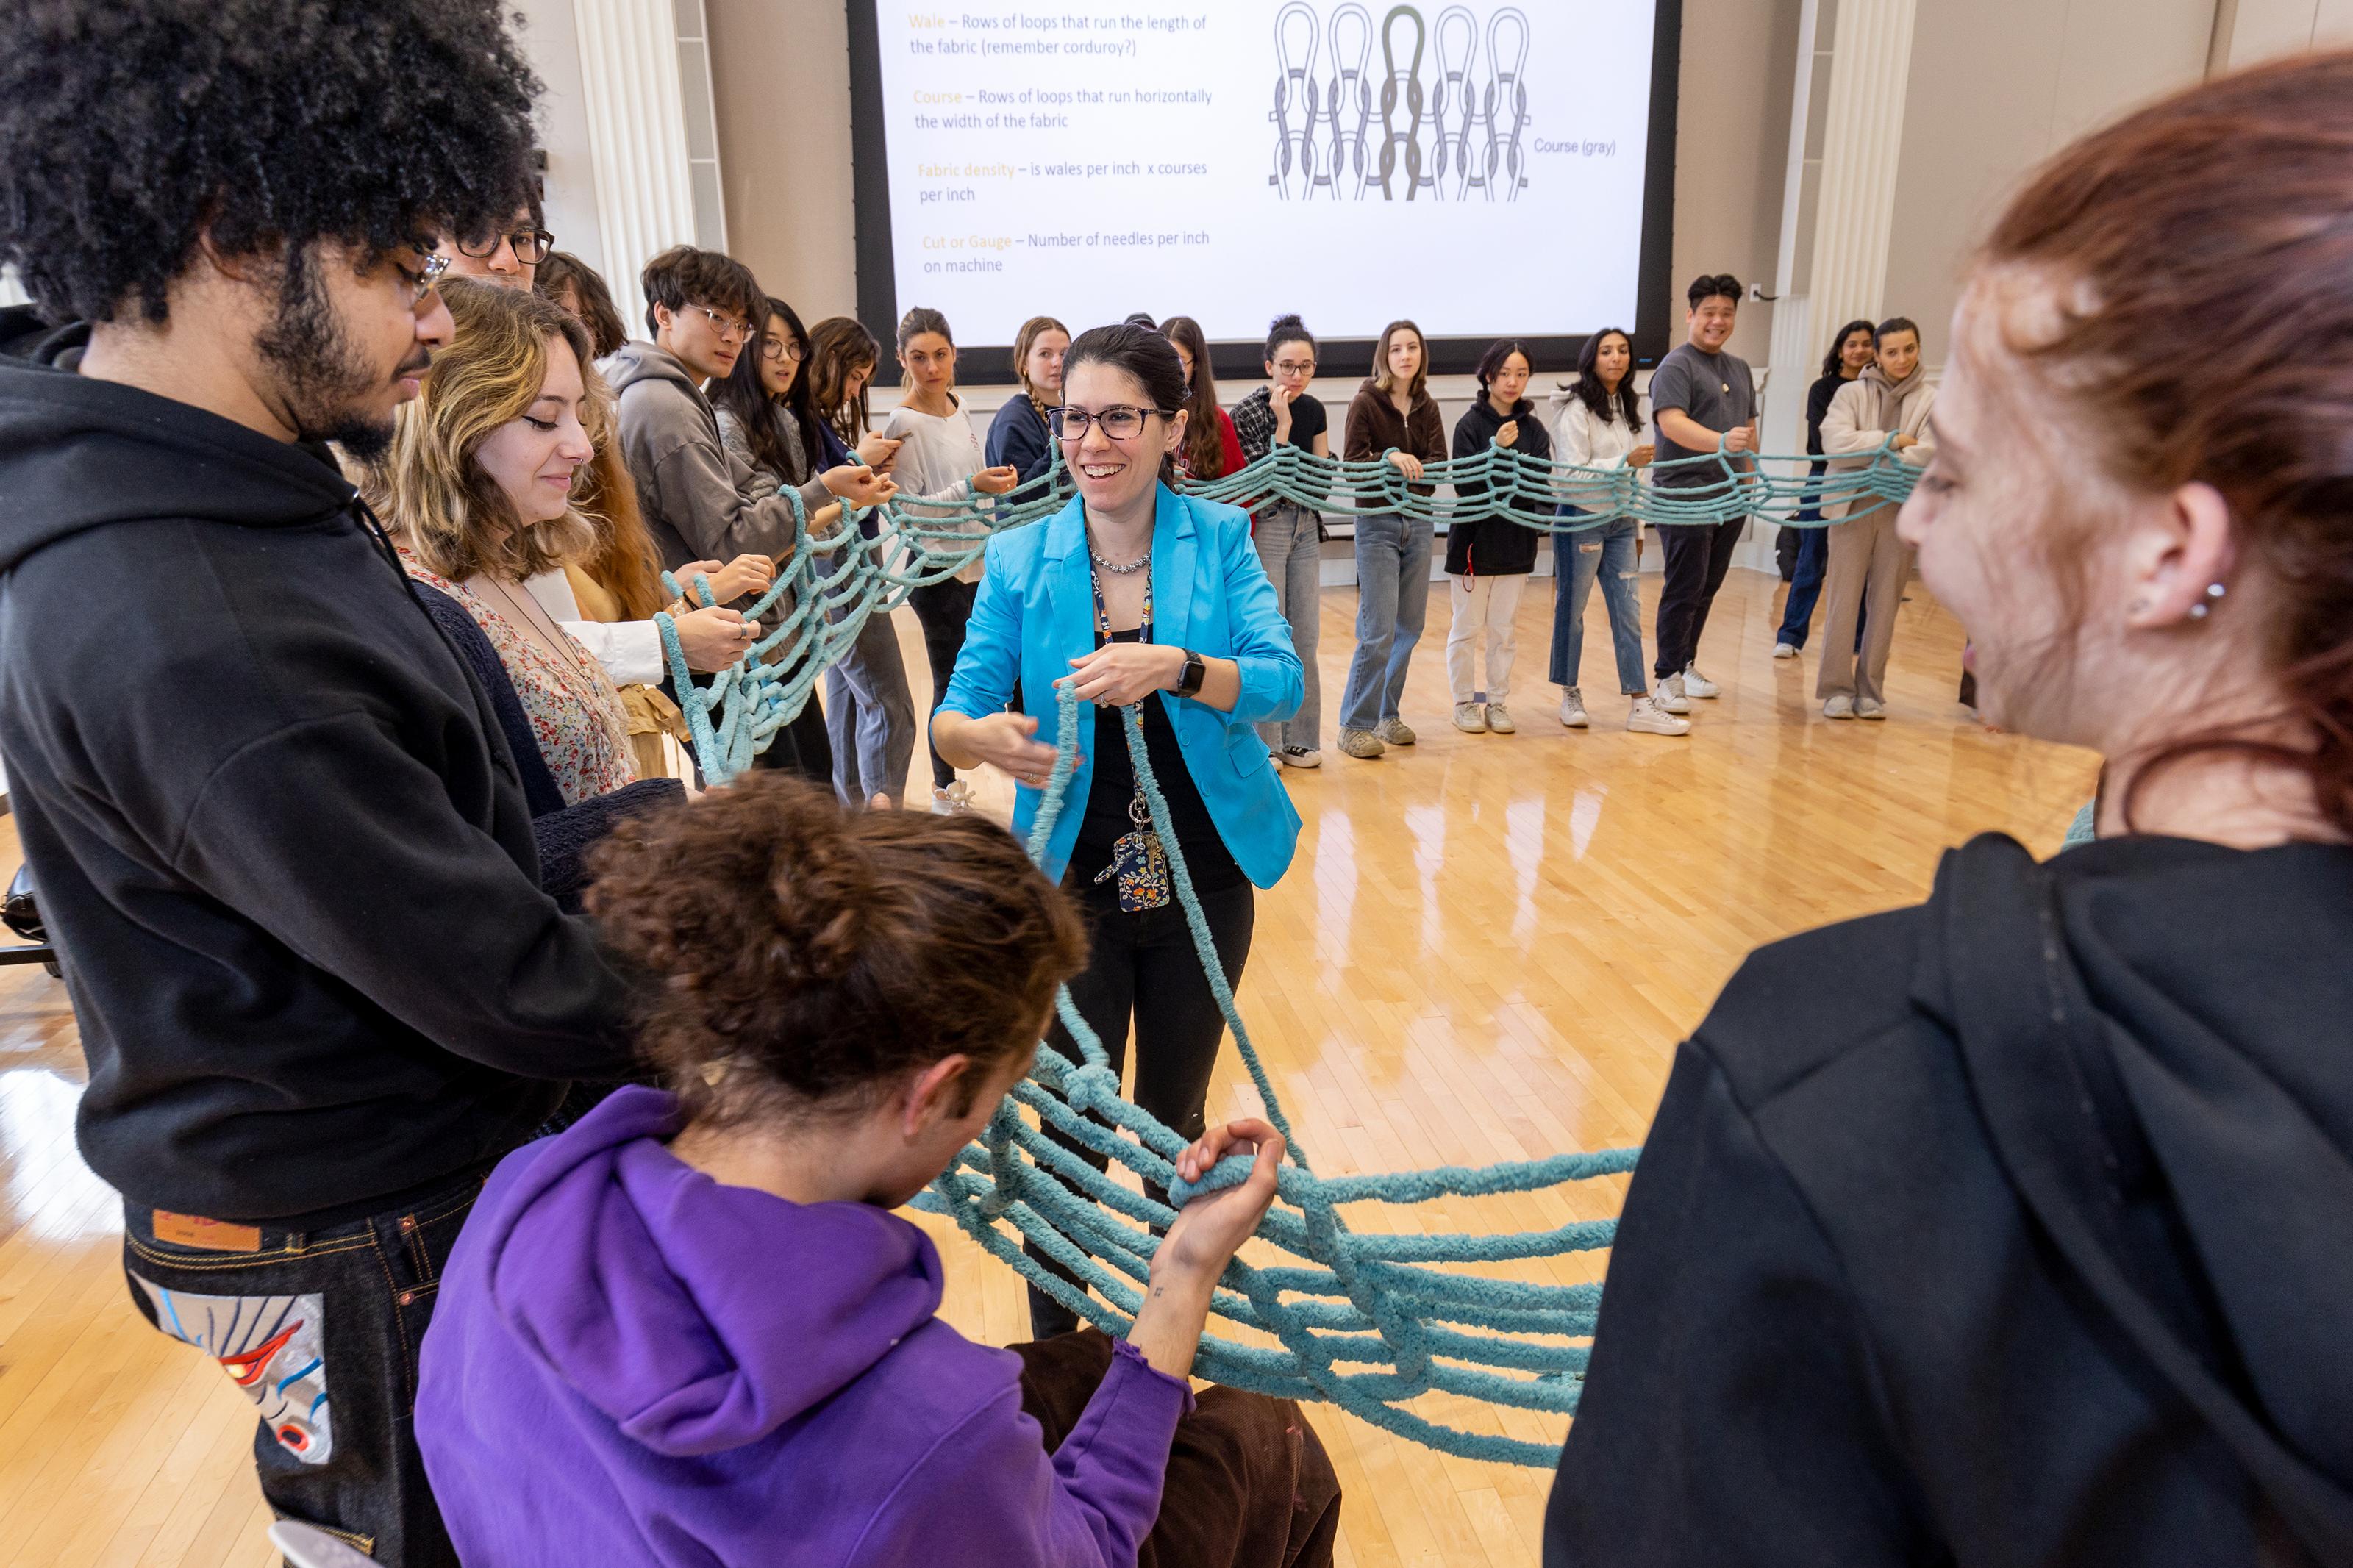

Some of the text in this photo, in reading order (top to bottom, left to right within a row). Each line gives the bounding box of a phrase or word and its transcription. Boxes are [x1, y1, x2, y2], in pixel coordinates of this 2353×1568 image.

[908, 14, 945, 29] Wale
[962, 14, 999, 29] Rows
[1002, 13, 1016, 29] of
[1021, 13, 1058, 32] loops
[1061, 14, 1089, 29] that
[1093, 18, 1117, 29] run
[1121, 15, 1143, 29] the
[1147, 15, 1189, 33] length
[1193, 15, 1207, 30] of
[910, 39, 1136, 57] the fabric (remember corduroy?)
[913, 90, 962, 104] Course
[979, 89, 1015, 104] Rows
[1018, 88, 1032, 104] of
[1036, 88, 1073, 107] loops
[1076, 88, 1104, 103] that
[1108, 92, 1131, 103] run
[1135, 88, 1213, 106] horizontally
[915, 112, 1068, 129] the width of the fabric
[1534, 137, 1616, 157] Course (gray)
[918, 163, 960, 177] Fabric
[964, 162, 1015, 180] density
[1030, 162, 1041, 176] is
[1044, 161, 1083, 176] wales
[1086, 164, 1109, 179] per
[1113, 160, 1140, 175] inch
[1147, 164, 1154, 175] x
[1158, 163, 1207, 175] courses
[920, 187, 975, 205] per inch
[923, 235, 946, 249] Cut
[950, 237, 964, 248] or
[968, 235, 1012, 251] Gauge
[1028, 232, 1082, 247] Number
[1085, 231, 1100, 246] of
[1103, 231, 1154, 246] needles
[1157, 234, 1179, 248] per
[1183, 230, 1210, 245] inch
[924, 257, 1003, 273] on machine
